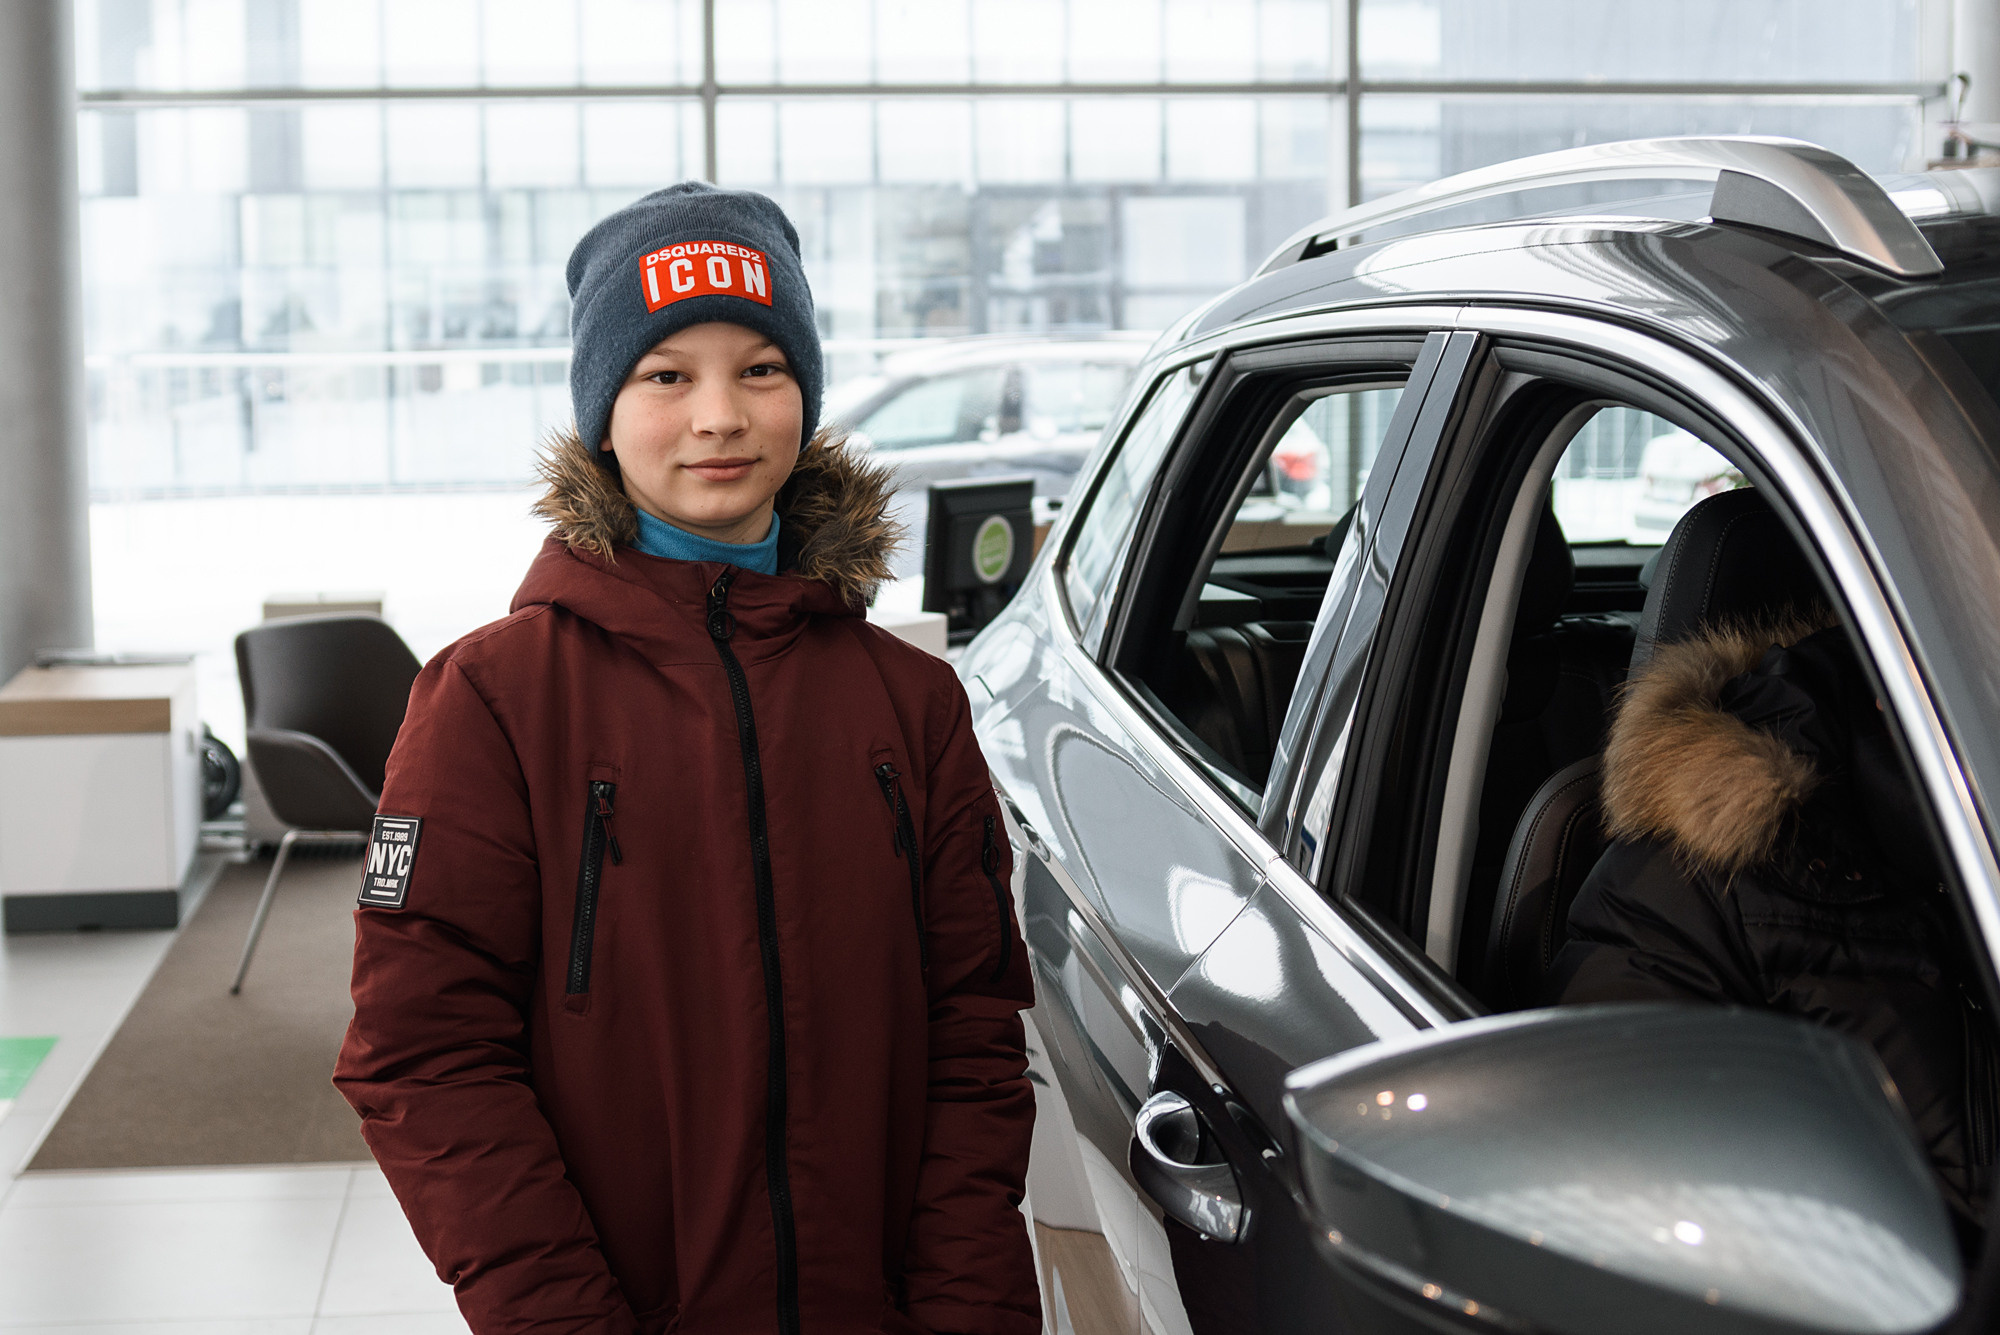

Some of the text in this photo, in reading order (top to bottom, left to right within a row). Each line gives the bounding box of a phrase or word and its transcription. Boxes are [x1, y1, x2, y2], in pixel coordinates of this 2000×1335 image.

[646, 243, 761, 266] DSQUARED2
[646, 256, 766, 303] ICON
[368, 842, 412, 876] NYC
